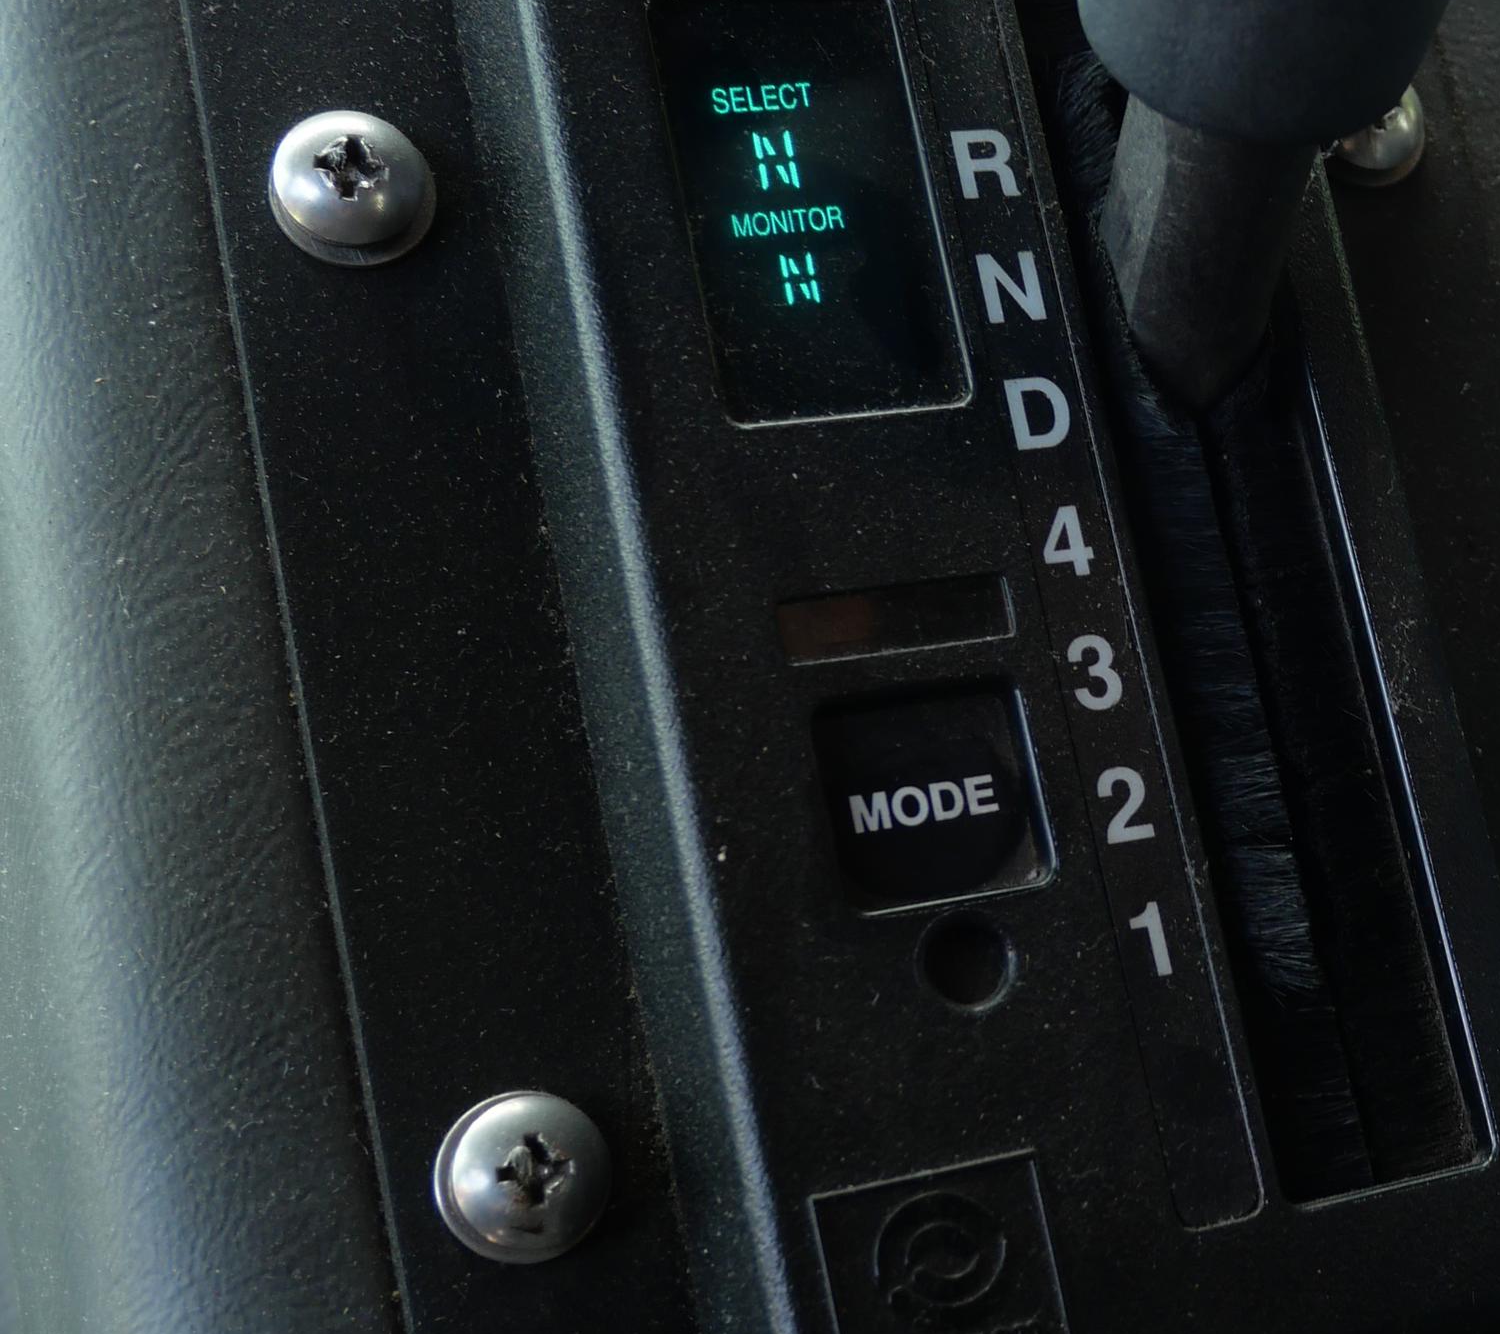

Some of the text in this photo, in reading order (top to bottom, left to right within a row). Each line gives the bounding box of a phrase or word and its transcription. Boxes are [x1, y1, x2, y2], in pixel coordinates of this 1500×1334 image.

[711, 82, 811, 115] SELECT
[753, 130, 800, 190] N
[950, 129, 1021, 199] R
[732, 205, 845, 238] MONITOR
[779, 252, 821, 305] N
[975, 251, 1047, 324] N
[1003, 376, 1071, 451] D
[1043, 505, 1095, 576] 4
[1067, 634, 1123, 711] 3
[849, 774, 1000, 833] MODE
[1097, 766, 1155, 845] 2
[1129, 901, 1173, 977] 1
